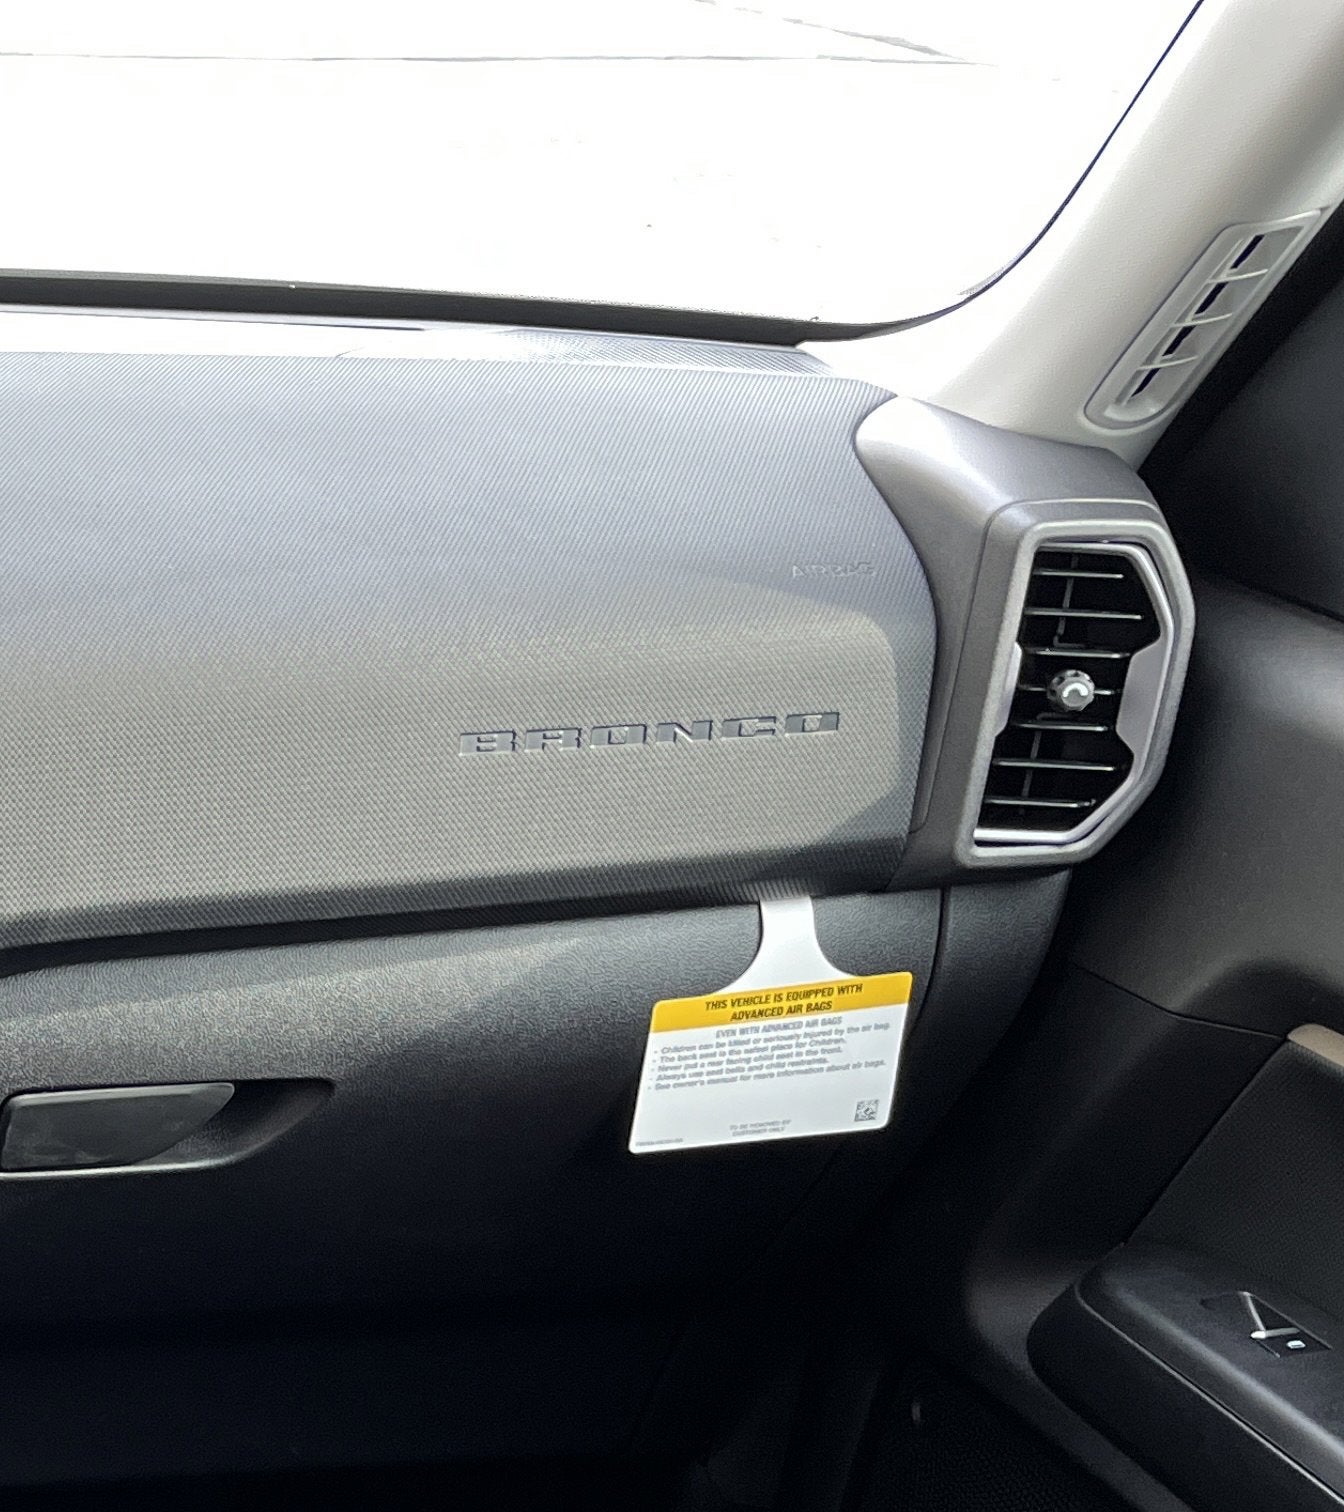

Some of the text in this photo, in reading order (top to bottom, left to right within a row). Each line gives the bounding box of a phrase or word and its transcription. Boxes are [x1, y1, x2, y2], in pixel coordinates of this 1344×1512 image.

[459, 711, 840, 756] BRONCO
[705, 984, 862, 1009] THIS VEHICLE IS EQUIPPED WITH
[730, 1001, 832, 1020] ADVANCED AIR BAGS
